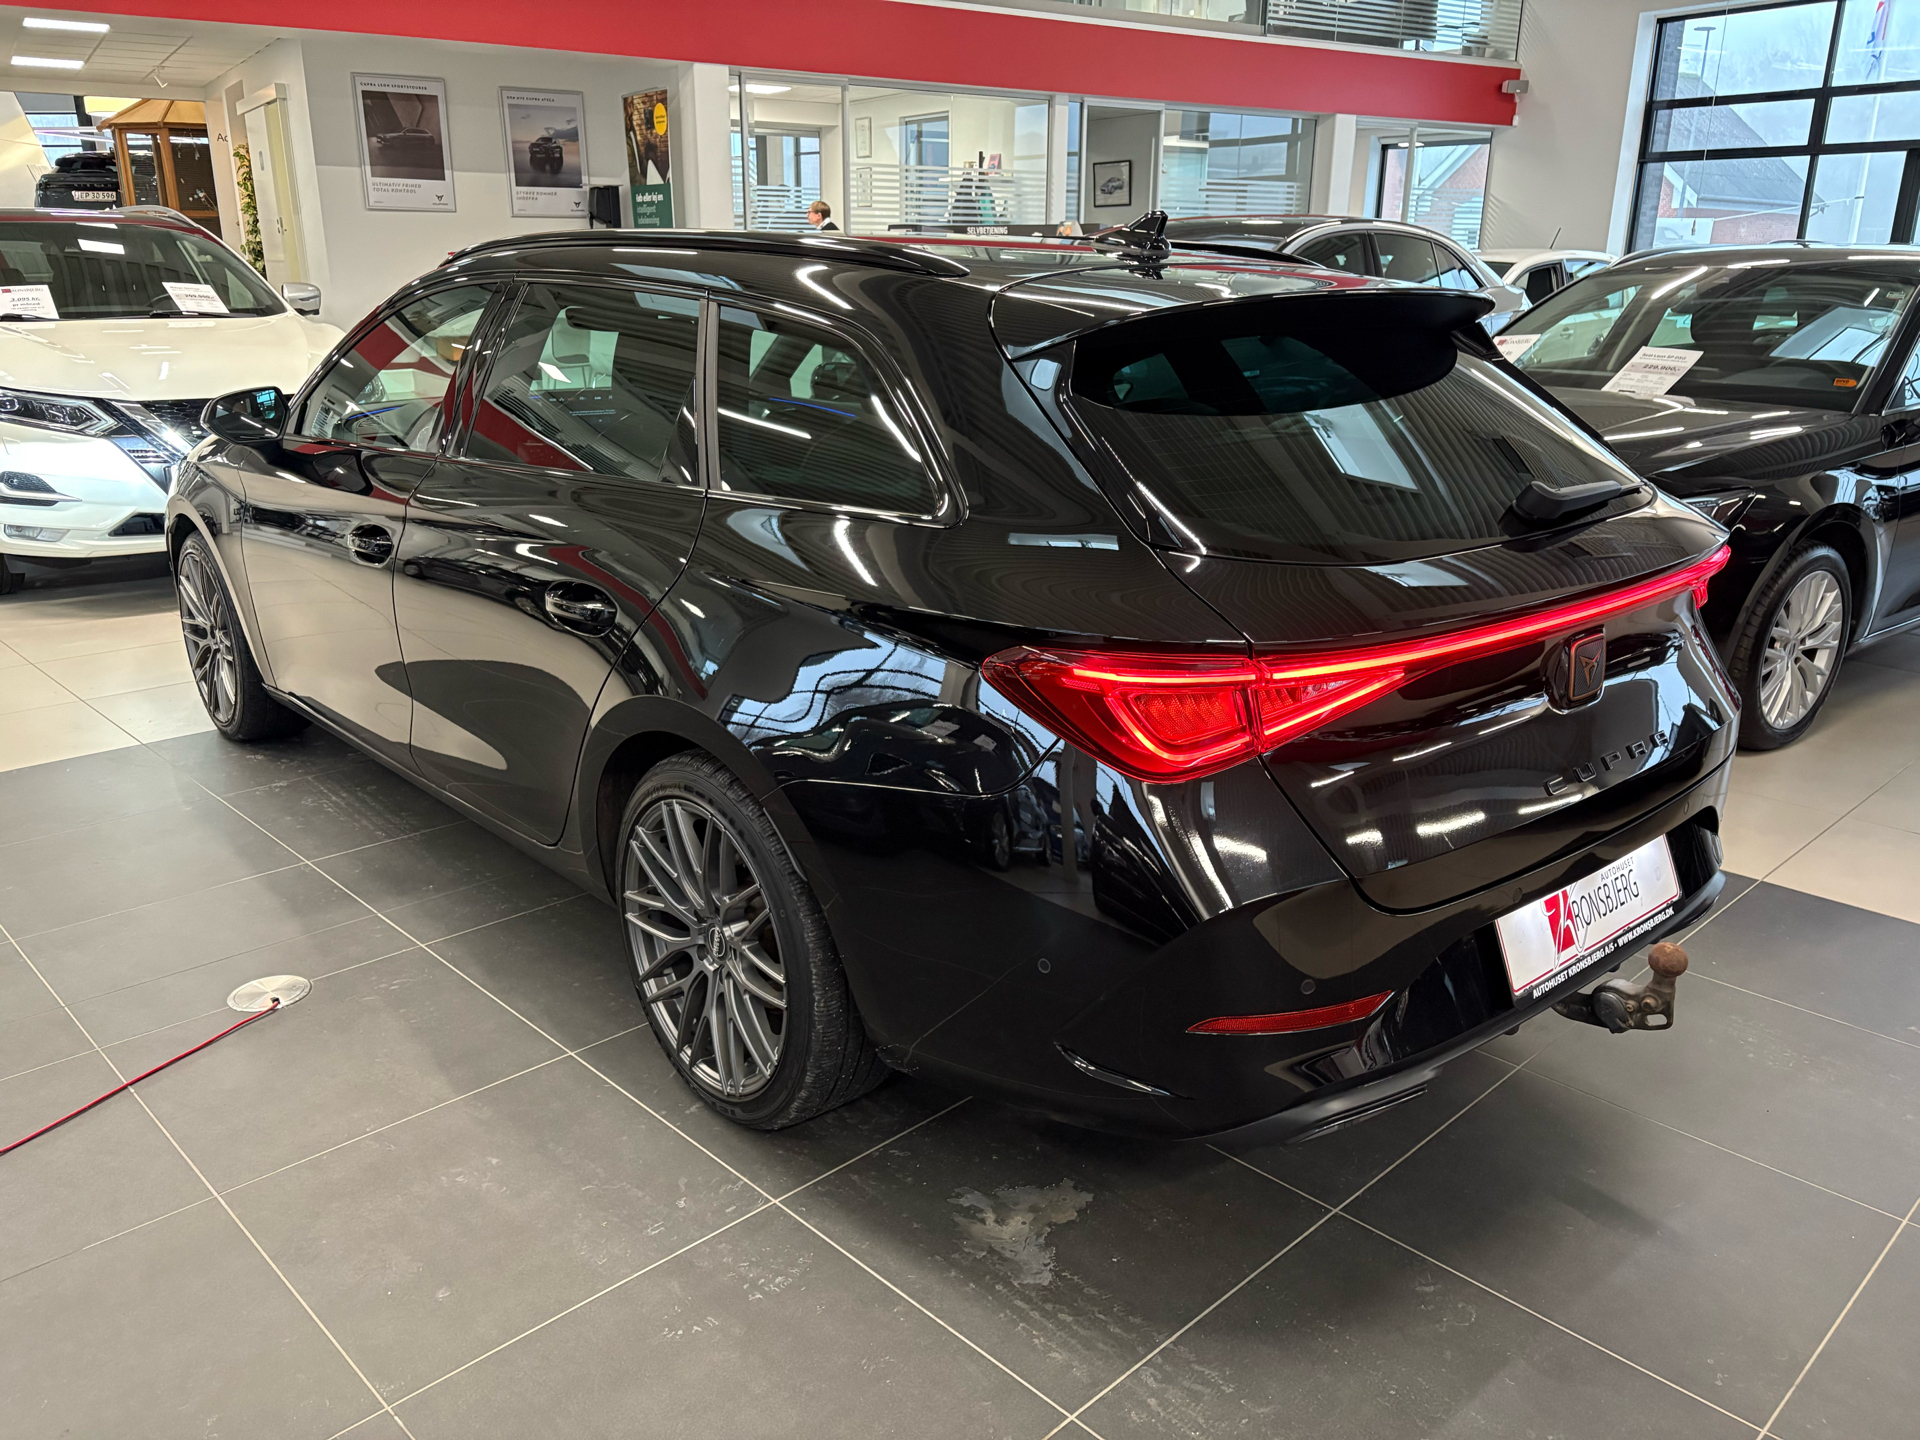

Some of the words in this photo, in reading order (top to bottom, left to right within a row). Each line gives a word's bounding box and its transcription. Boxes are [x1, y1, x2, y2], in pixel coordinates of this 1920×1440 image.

[967, 226, 1008, 235] SELVBETJENING
[1543, 730, 1671, 797] CUPRA
[1600, 857, 1634, 881] AUTOHUSET
[1532, 971, 1569, 999] AUTOHUSET
[1568, 949, 1605, 978] KRONSBJERG
[1604, 943, 1615, 956] A/S
[1617, 906, 1675, 948] WWW.KRONSBJERG.DK
